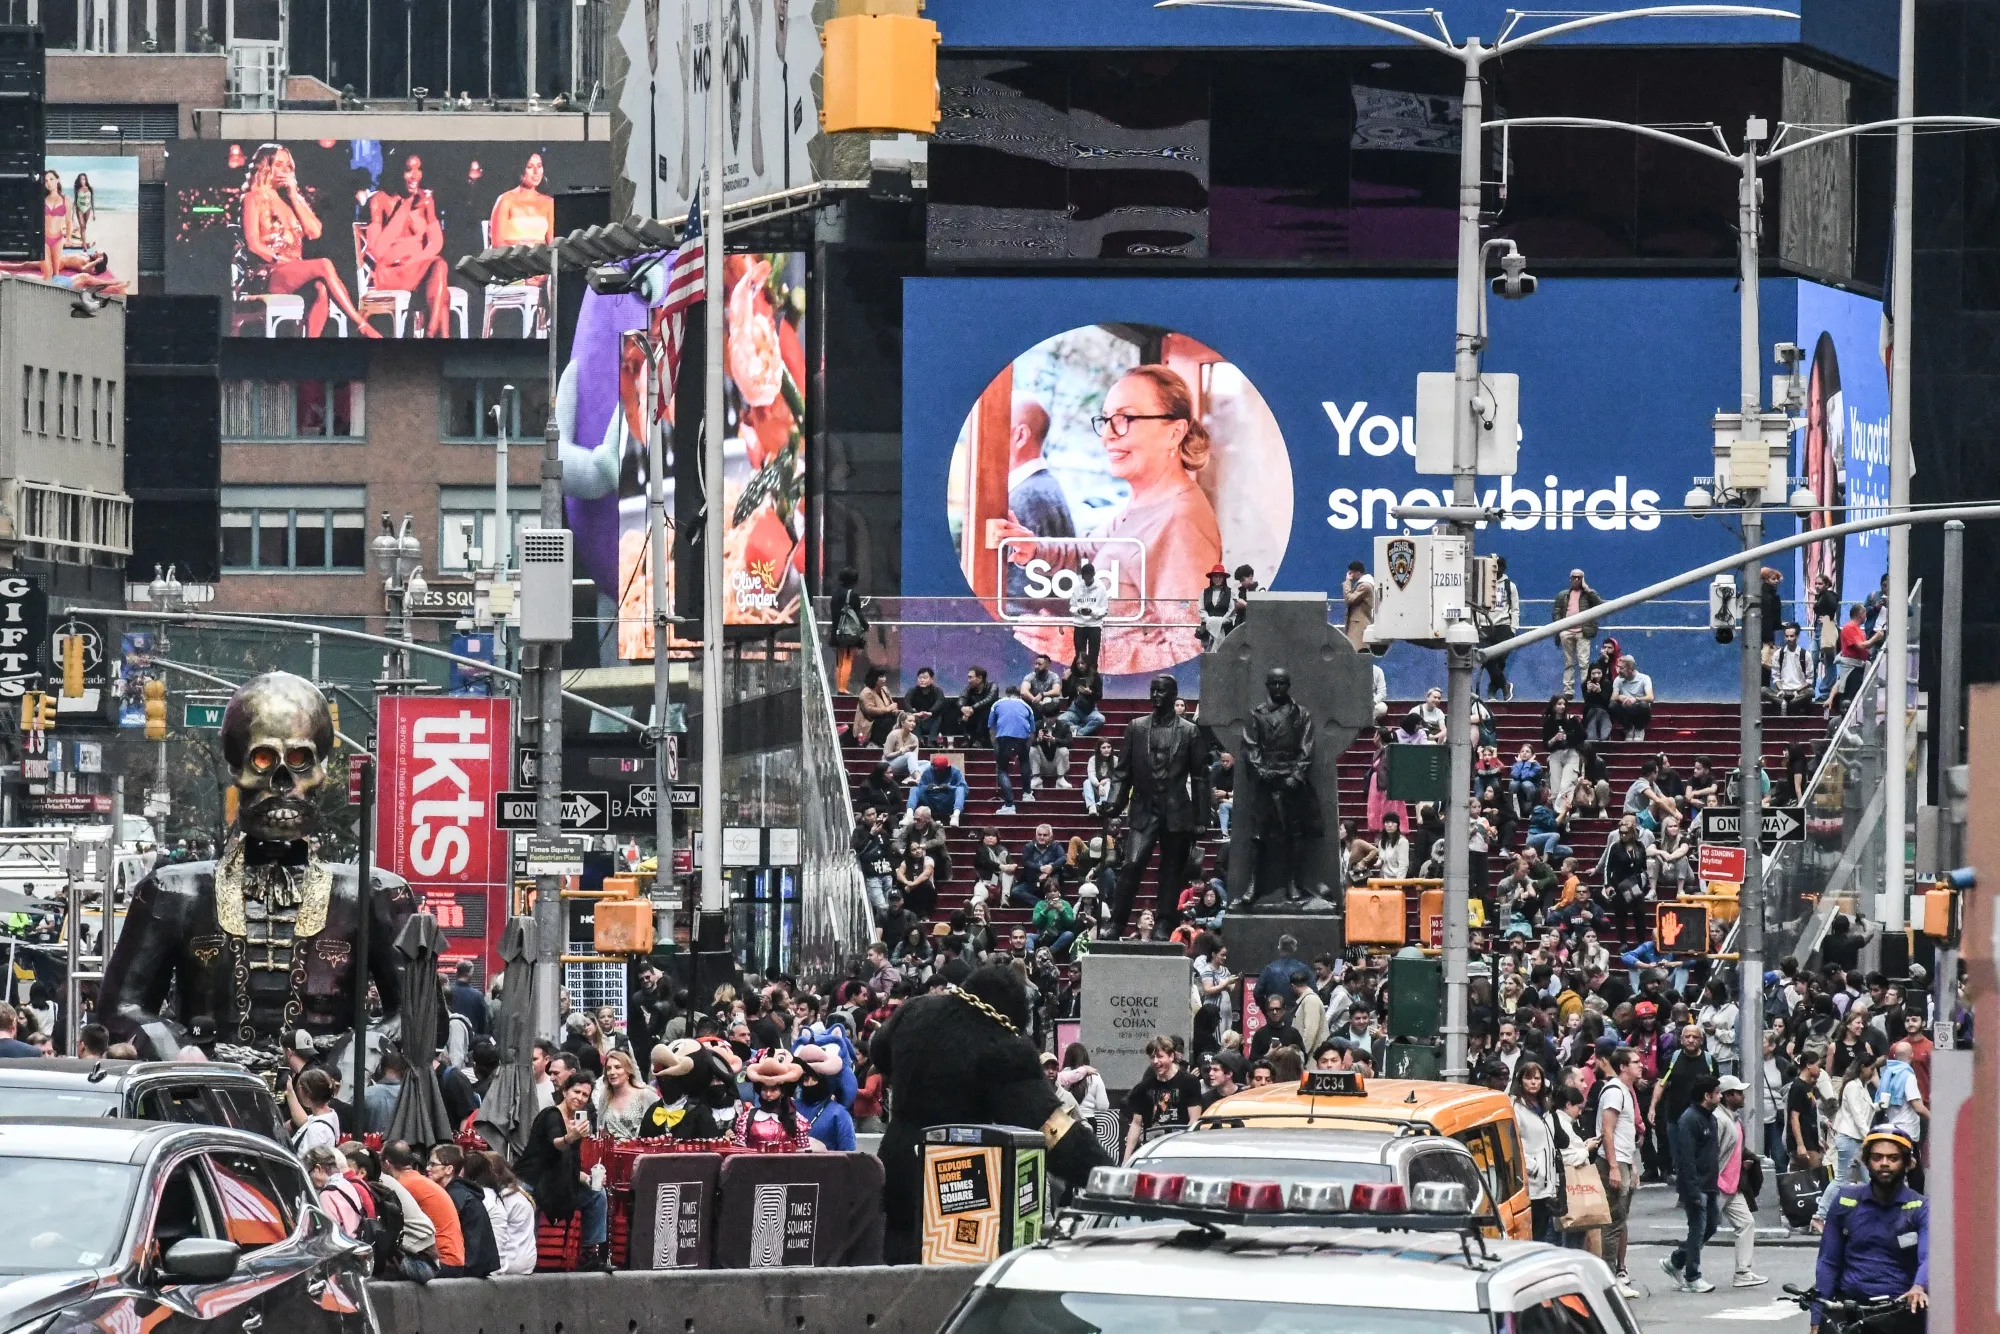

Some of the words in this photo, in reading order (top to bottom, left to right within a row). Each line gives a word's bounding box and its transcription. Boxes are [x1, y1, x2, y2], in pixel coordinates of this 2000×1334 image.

[693, 34, 749, 94] MOMON
[1849, 405, 1866, 461] You
[1867, 417, 1883, 477] got
[732, 569, 762, 591] Olive
[1023, 558, 1120, 598] Sod
[1434, 573, 1462, 587] 726161
[736, 588, 778, 612] Garden
[1446, 608, 1462, 618] NYPD
[0, 578, 30, 697] GIFTS
[205, 709, 219, 723] W
[400, 757, 407, 766] of
[399, 768, 407, 796] theatre
[410, 710, 489, 876] tkts
[672, 792, 691, 802] WAY
[561, 803, 591, 818] WAY
[397, 800, 406, 853] development
[1762, 818, 1790, 831] WAY
[530, 845, 549, 853] Times
[550, 845, 575, 854] Square
[1711, 850, 1735, 858] STANDING
[1701, 857, 1723, 865] Anytime
[605, 962, 623, 970] REFILL
[568, 971, 581, 979] FREE
[605, 971, 623, 979] REFILL
[1110, 996, 1159, 1007] GEORGE
[1129, 1009, 1141, 1018] M
[1113, 1018, 1156, 1028] COHAN
[1315, 1076, 1345, 1090] 2C34
[937, 1159, 972, 1173] EXPLORE
[938, 1171, 962, 1183] MORE
[940, 1182, 950, 1194] IN
[949, 1179, 974, 1191] TIMES
[941, 1190, 974, 1204] SQUARE
[682, 1201, 697, 1215] TIMES
[790, 1202, 812, 1216] TIMES
[786, 1220, 813, 1234] SQUARE
[786, 1238, 810, 1249] ALLIANCE
